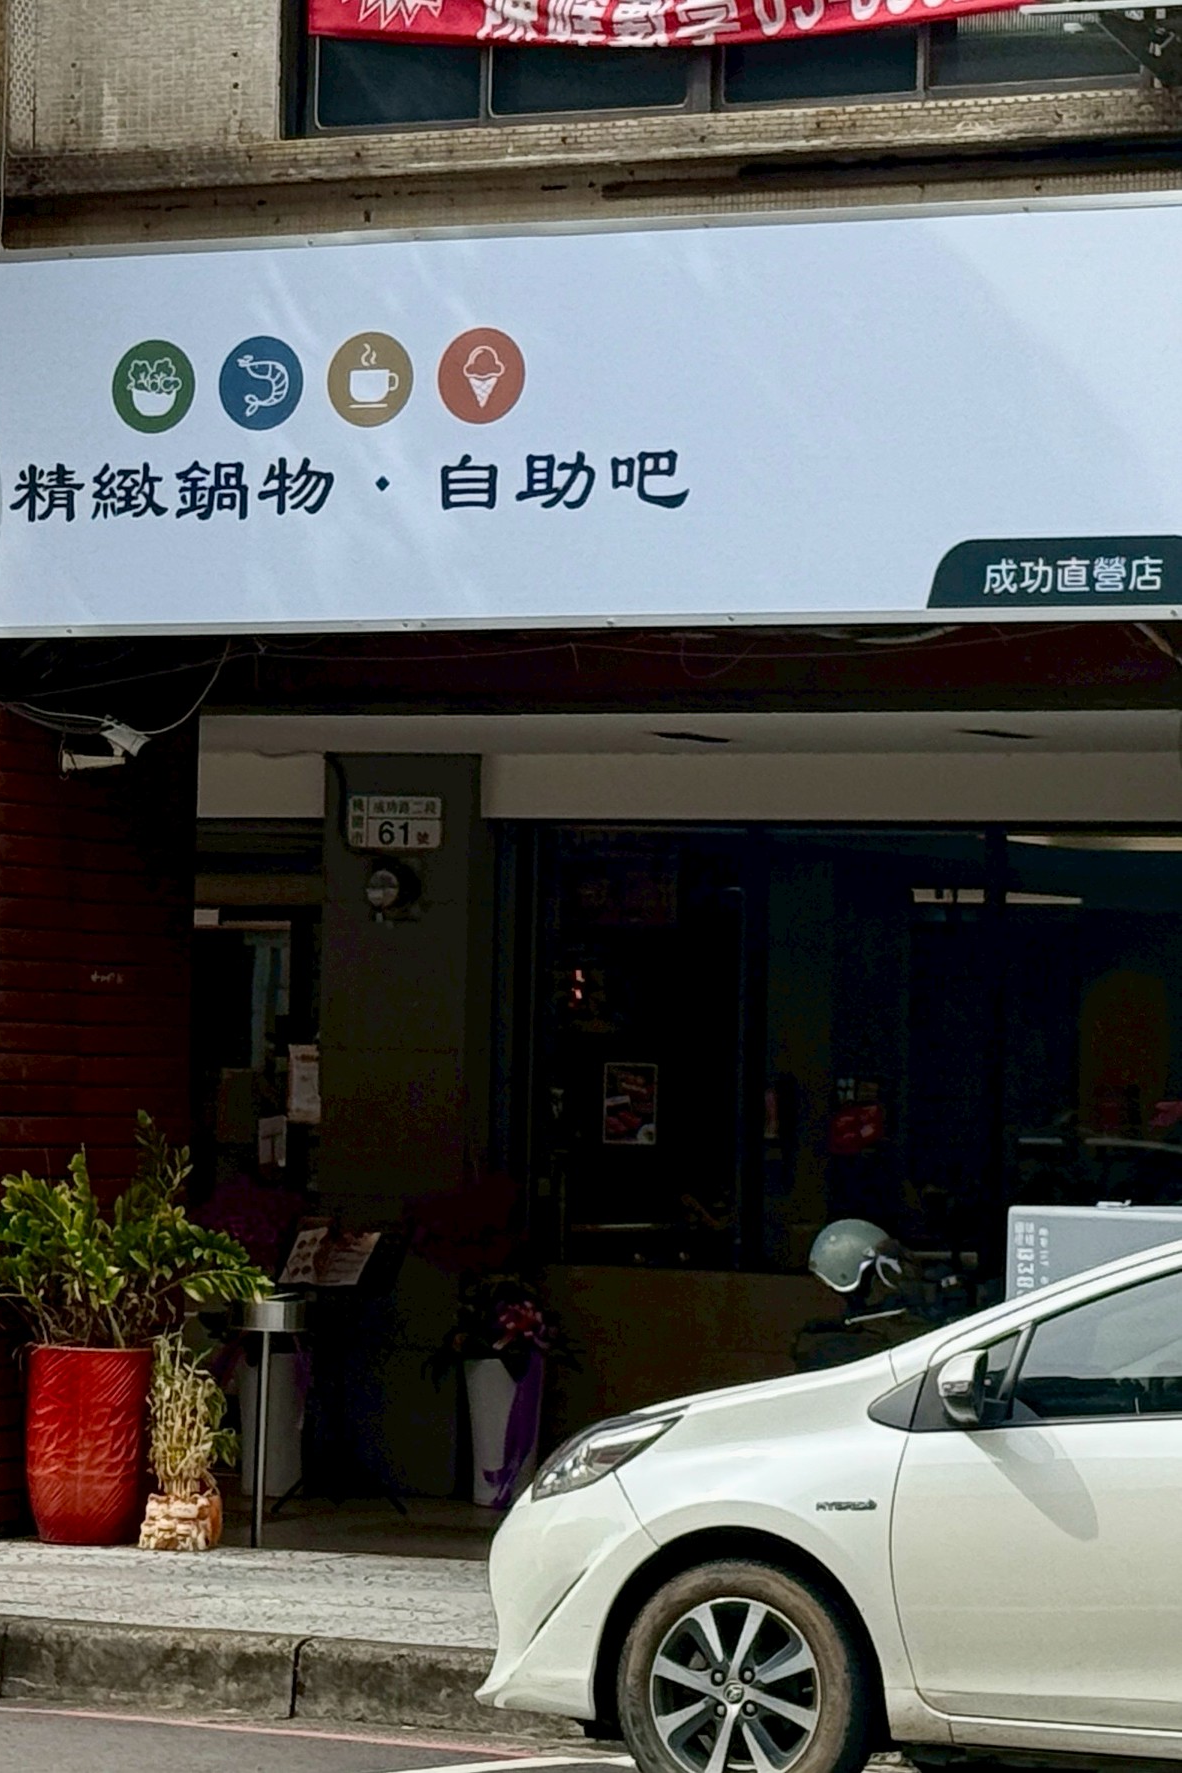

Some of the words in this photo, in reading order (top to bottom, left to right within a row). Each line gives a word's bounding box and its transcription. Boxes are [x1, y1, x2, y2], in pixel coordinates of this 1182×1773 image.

[983, 556, 1164, 594] 成功直營店
[379, 820, 409, 845] 61
